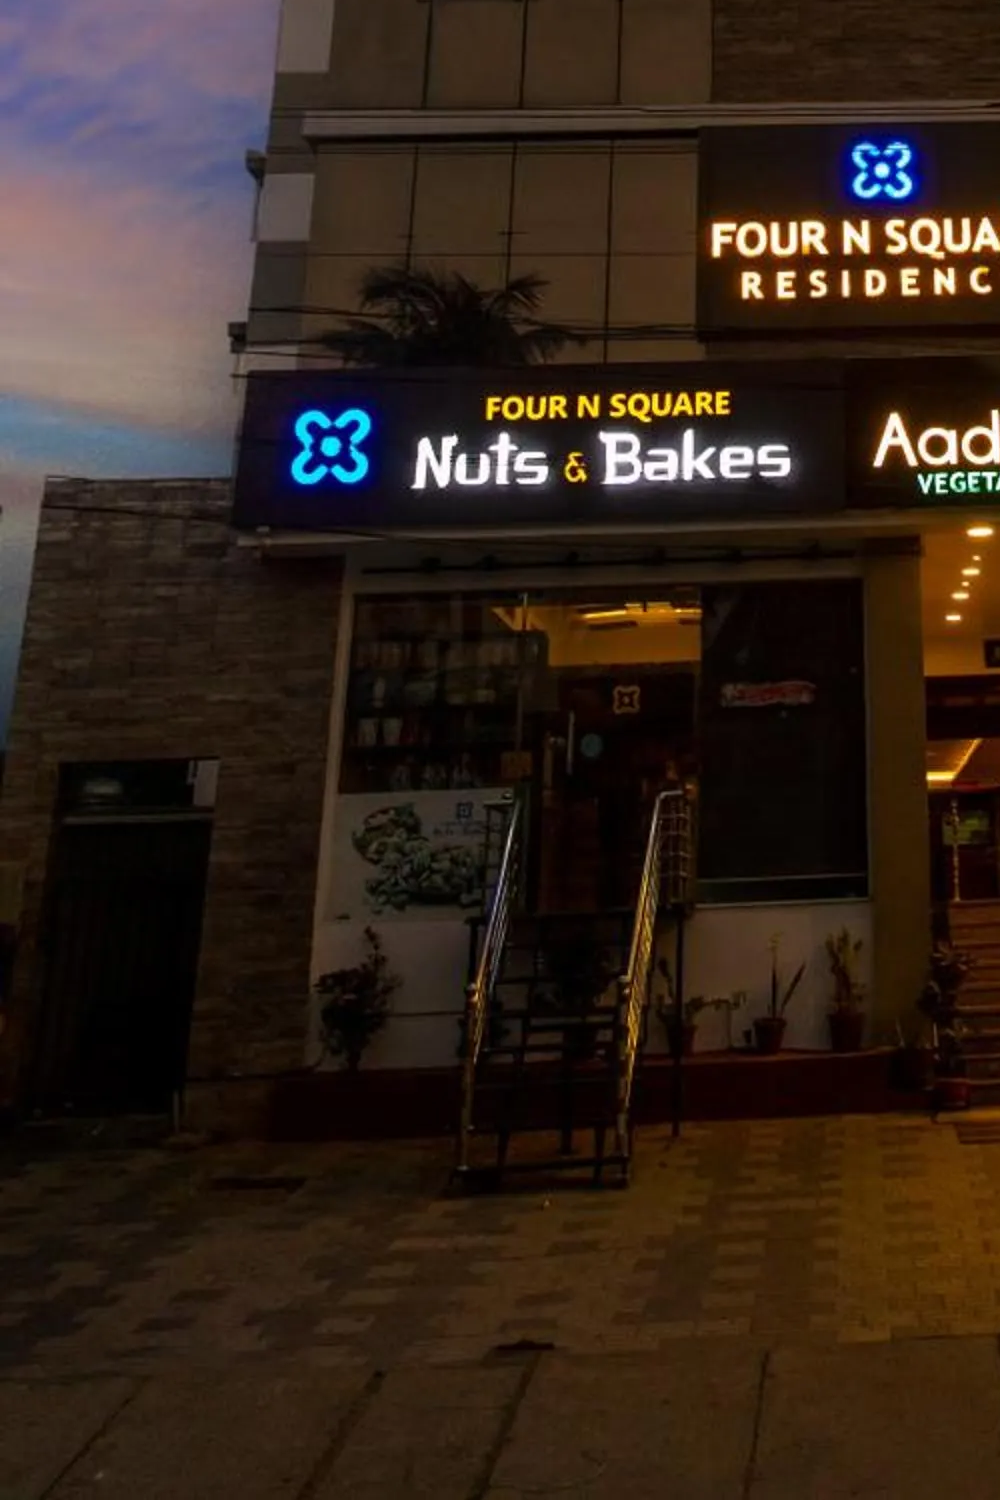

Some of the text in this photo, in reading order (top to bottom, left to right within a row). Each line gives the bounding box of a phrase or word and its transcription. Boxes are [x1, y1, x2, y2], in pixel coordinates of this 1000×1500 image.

[710, 220, 829, 259] FOUR
[842, 219, 871, 256] N
[485, 390, 732, 422] FOUR N SQUARE
[411, 428, 793, 490] Nuts & Bakes
